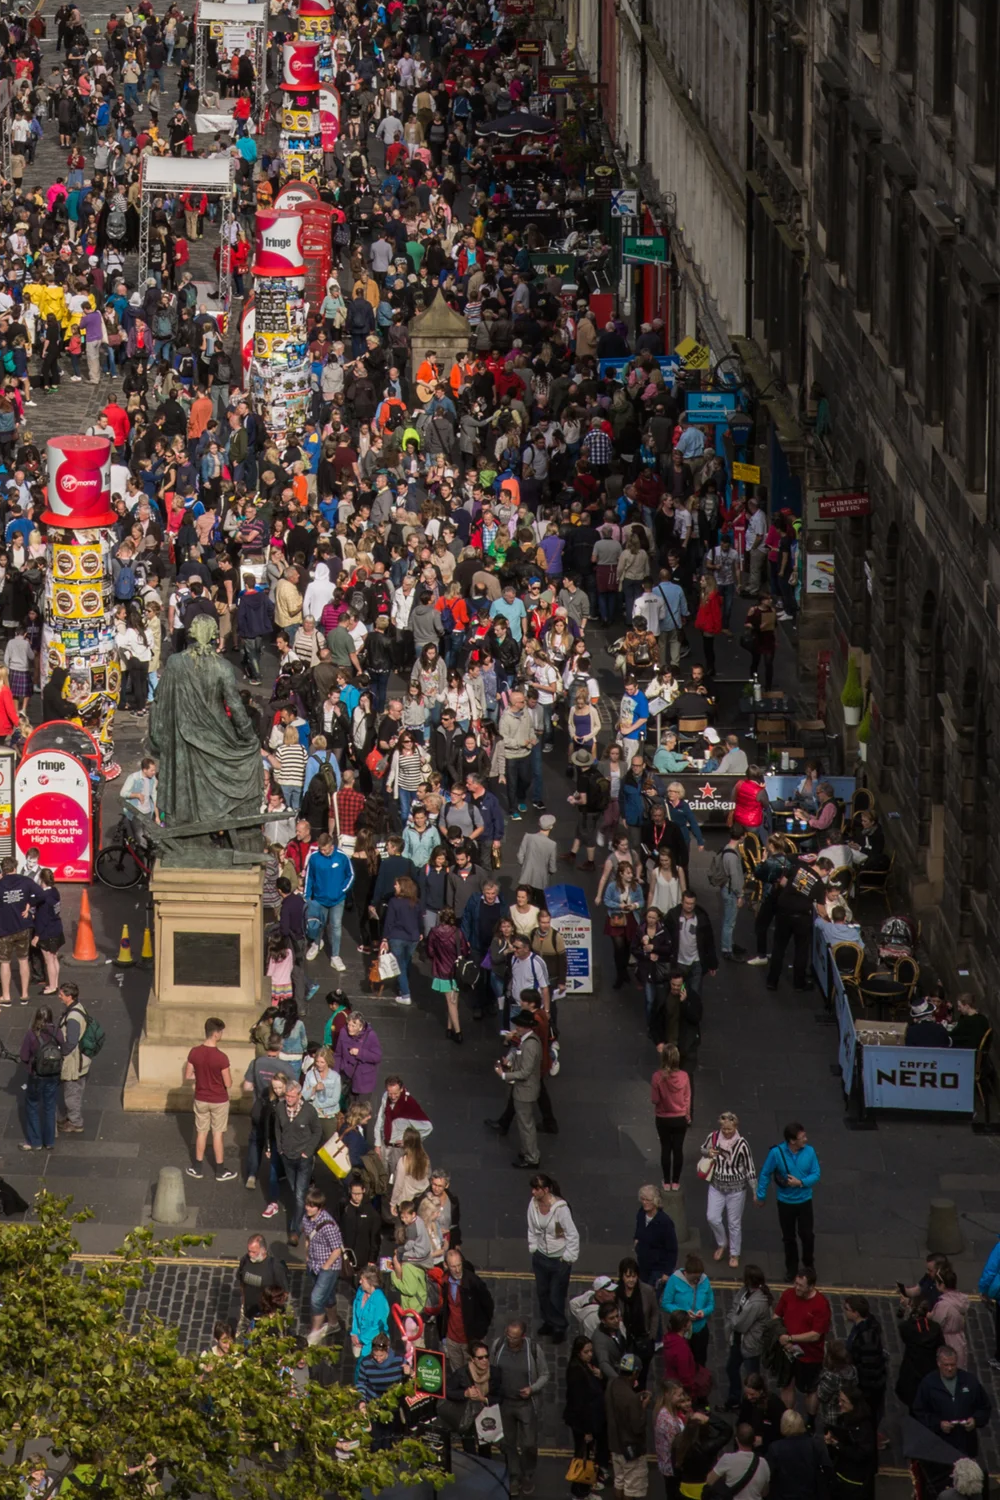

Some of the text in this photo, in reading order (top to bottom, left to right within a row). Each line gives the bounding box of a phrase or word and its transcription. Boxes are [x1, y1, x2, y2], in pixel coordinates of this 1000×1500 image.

[265, 236, 291, 248] fringe
[37, 760, 65, 772] fringe
[687, 800, 736, 810] eineken
[26, 818, 78, 826] The bank that
[22, 827, 57, 836] performs
[70, 827, 82, 835] the
[31, 836, 49, 845] High
[877, 1069, 958, 1089] NERO
[418, 1366, 432, 1375] Green
[422, 1372, 440, 1380] Tourism
